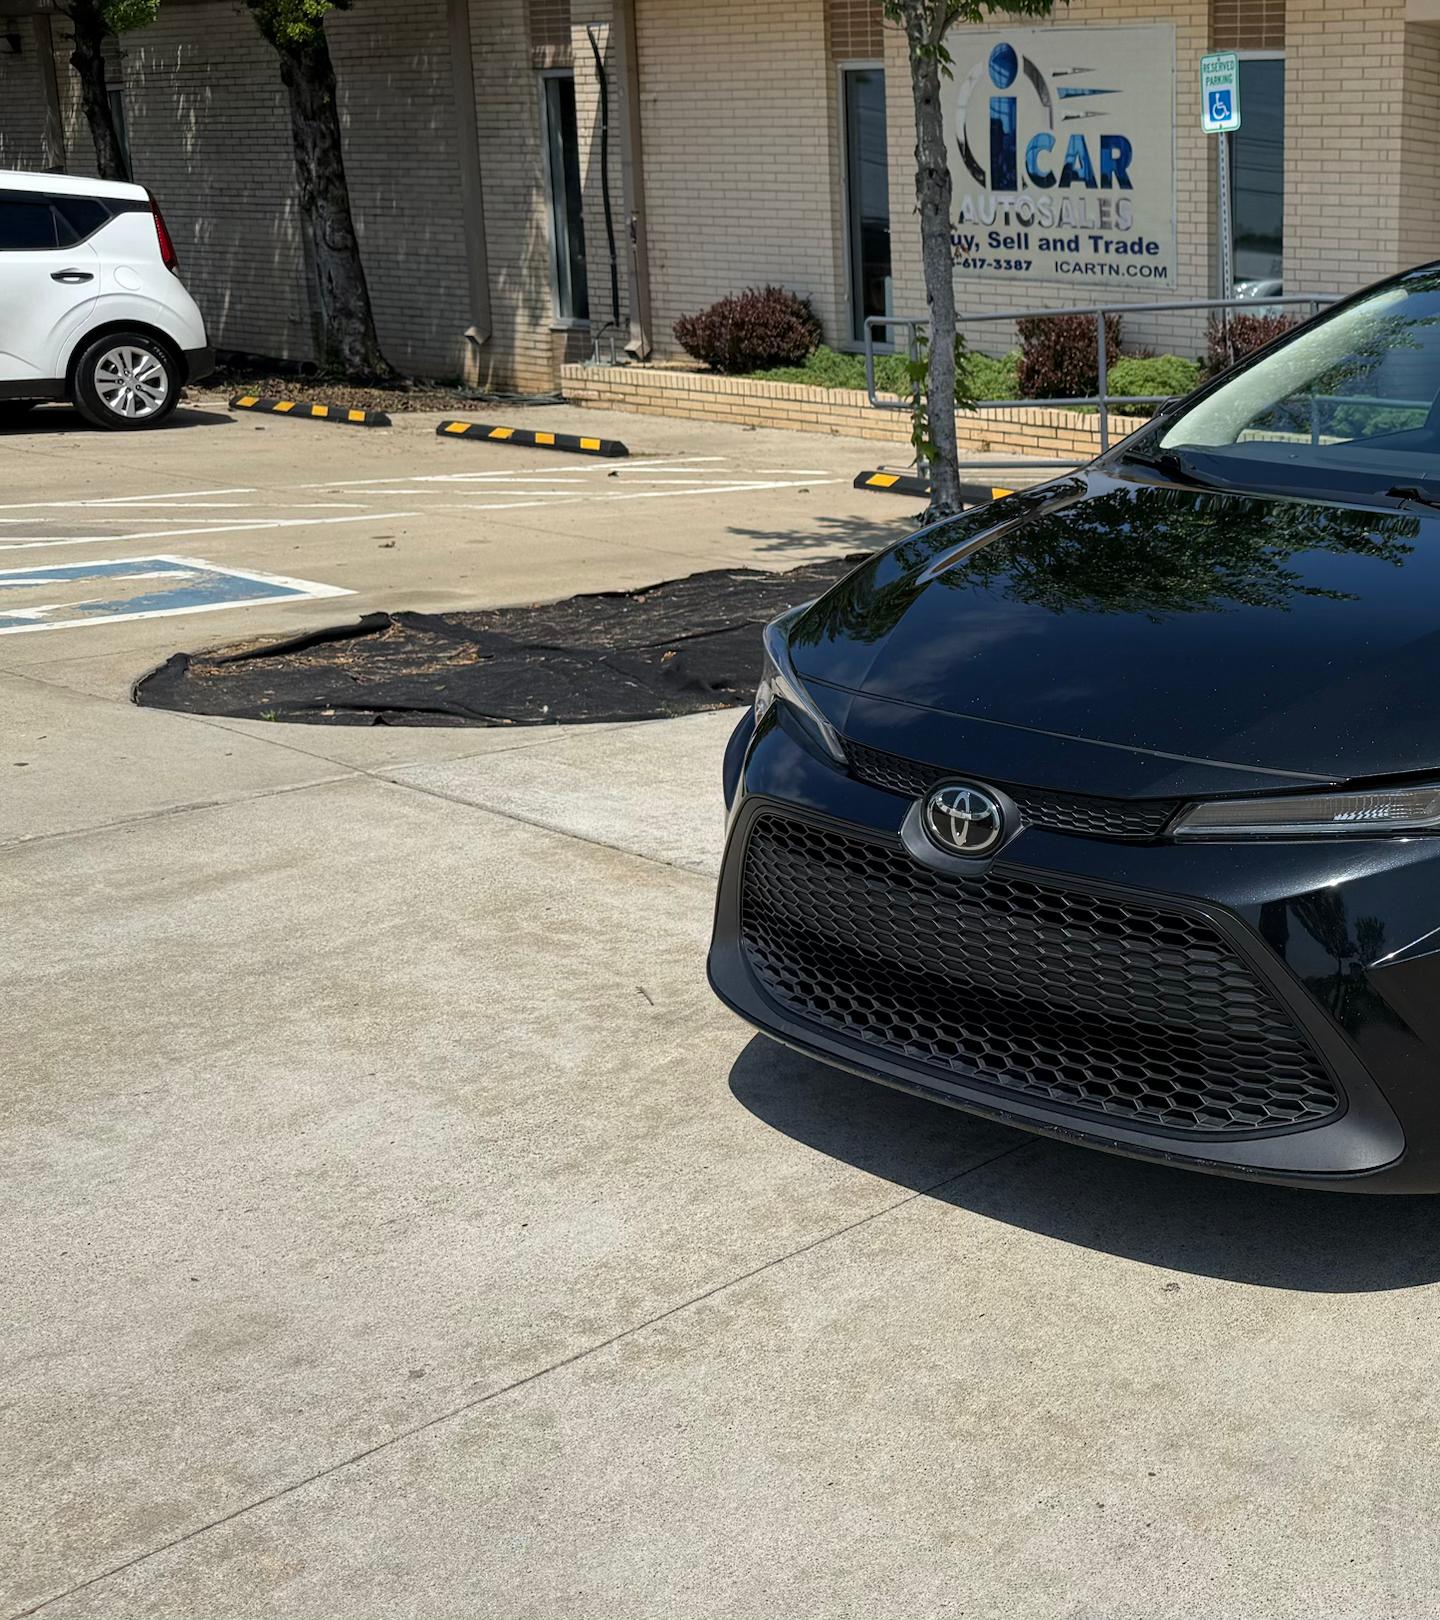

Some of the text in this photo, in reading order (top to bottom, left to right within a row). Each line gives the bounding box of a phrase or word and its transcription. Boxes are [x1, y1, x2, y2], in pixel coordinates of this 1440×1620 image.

[1203, 60, 1235, 73] RESERVED
[1206, 74, 1232, 87] PARKING
[959, 194, 1134, 232] AUTOSALES
[951, 231, 1160, 256] uy, Sell and Trade
[1055, 261, 1168, 279] ICARTN.COM
